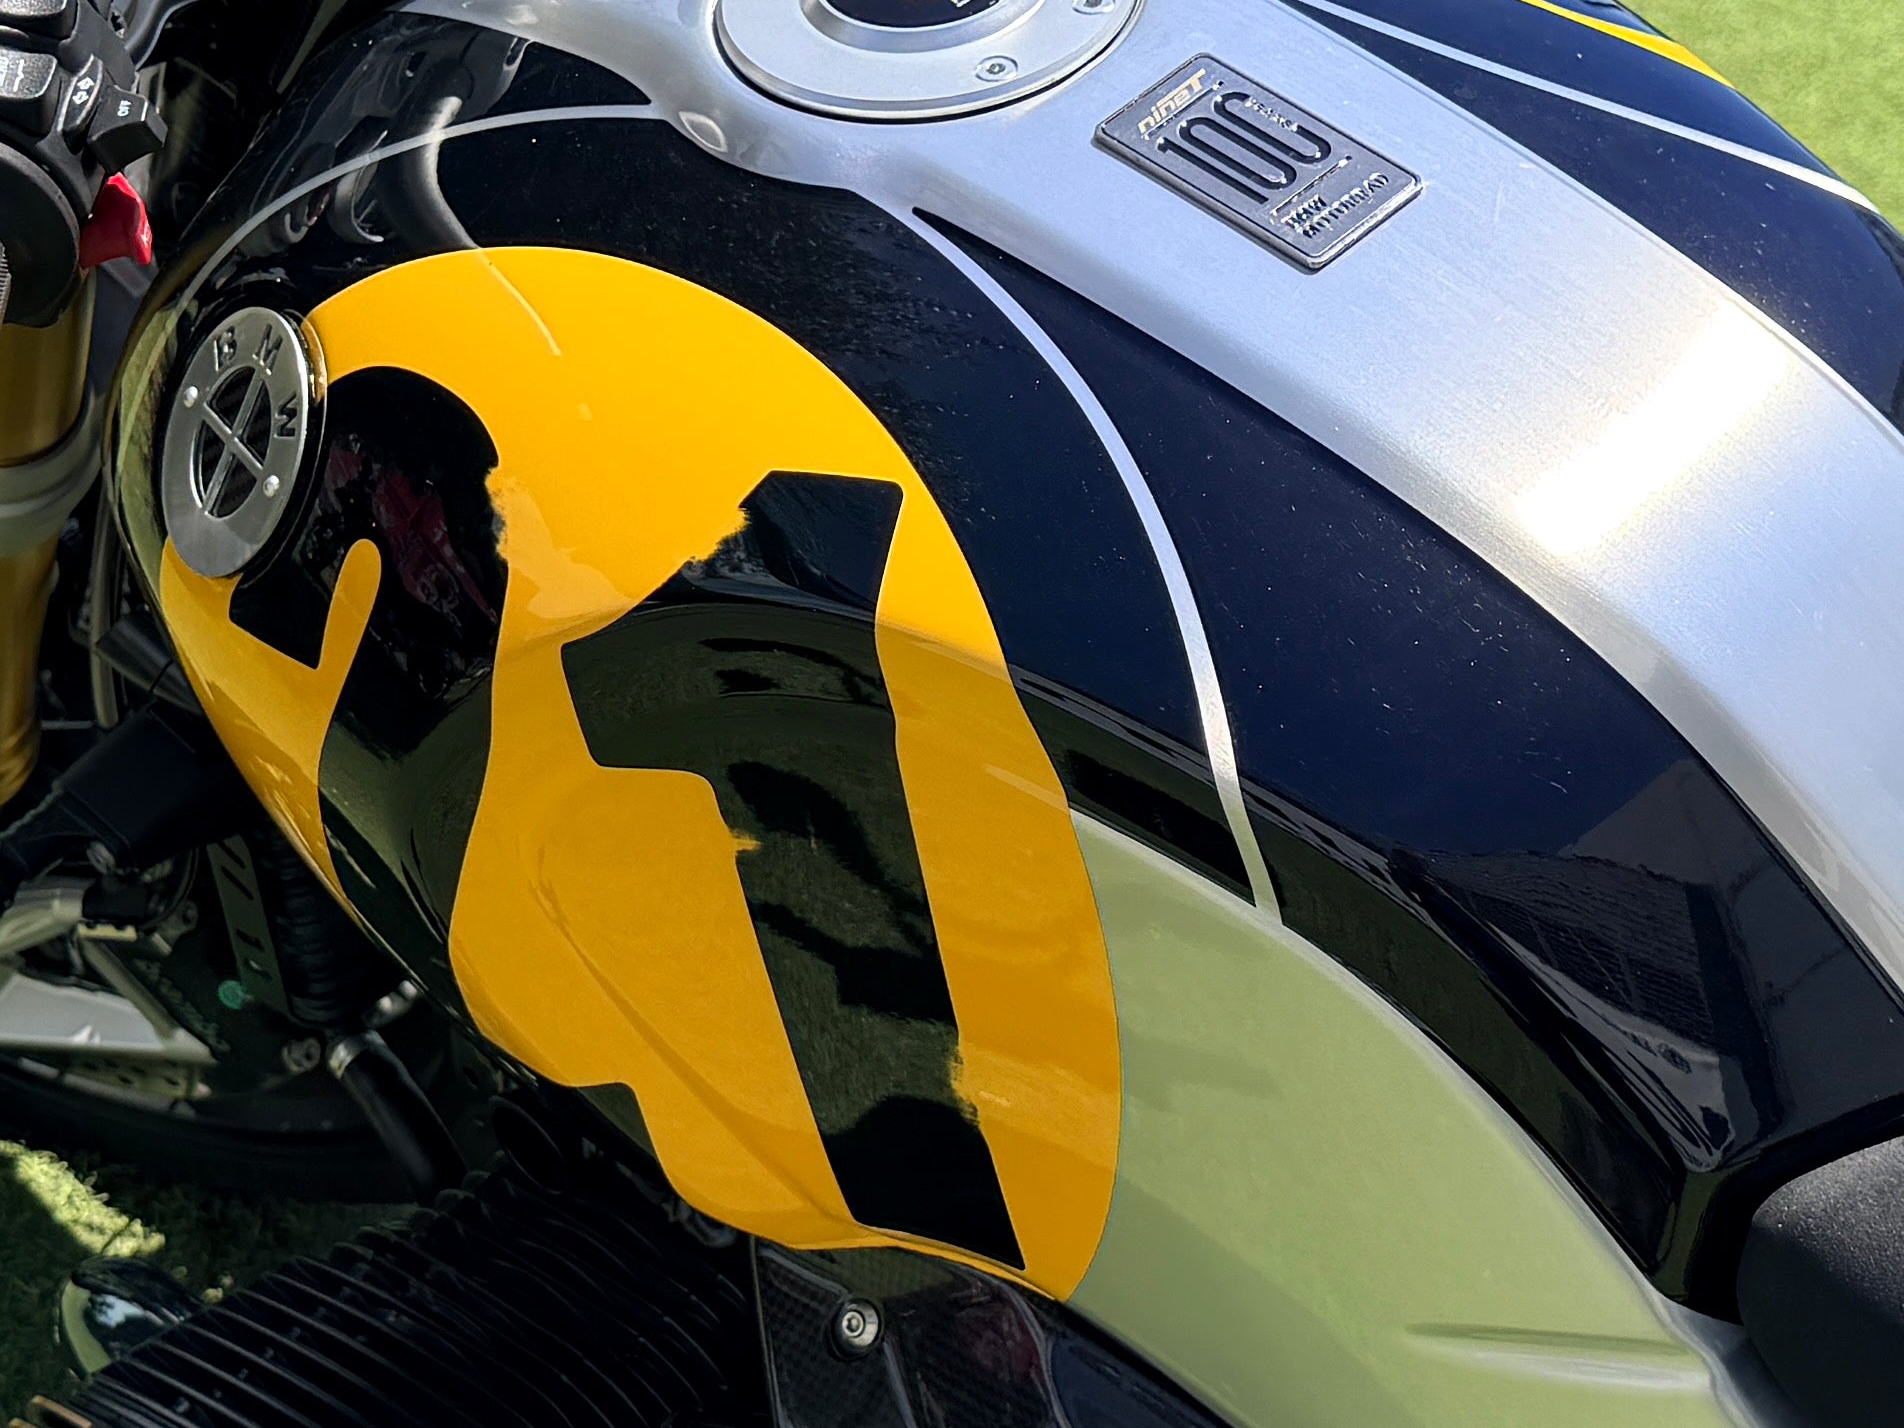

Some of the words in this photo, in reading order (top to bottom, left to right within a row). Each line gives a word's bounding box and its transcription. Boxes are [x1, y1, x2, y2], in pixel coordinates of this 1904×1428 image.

[1137, 68, 1206, 134] nineT
[1157, 91, 1332, 205] 100
[1297, 173, 1389, 239] MOTORRAD
[213, 322, 298, 439] BMW
